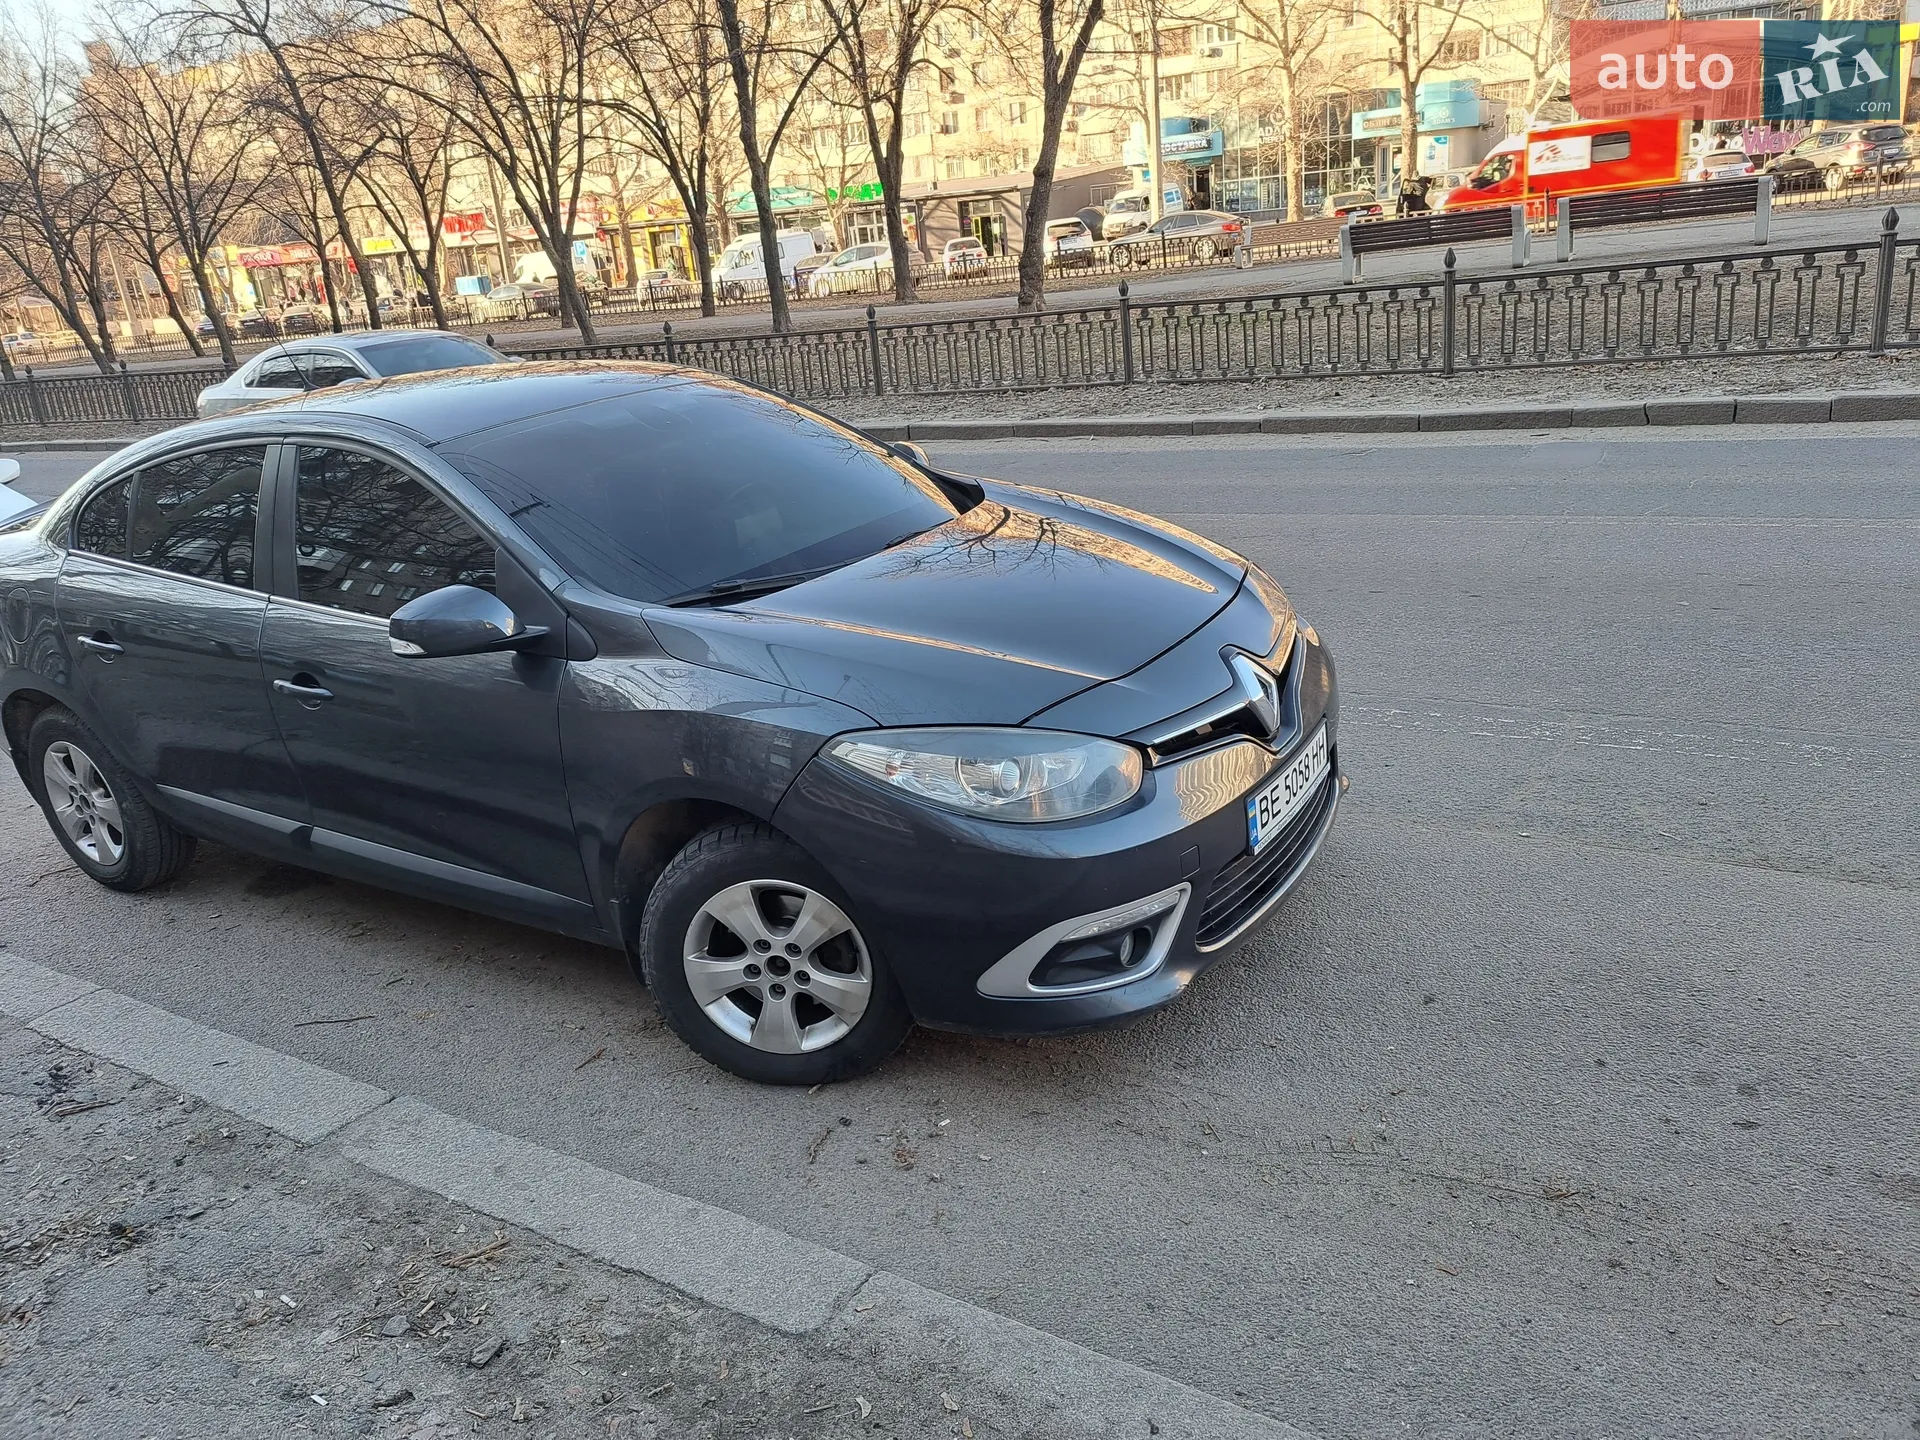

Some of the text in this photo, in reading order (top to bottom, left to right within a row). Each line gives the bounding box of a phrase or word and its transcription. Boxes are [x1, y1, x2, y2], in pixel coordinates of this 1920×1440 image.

[1259, 783, 1282, 831] BE
[1284, 753, 1311, 806] 5058
[1311, 731, 1326, 775] HH
